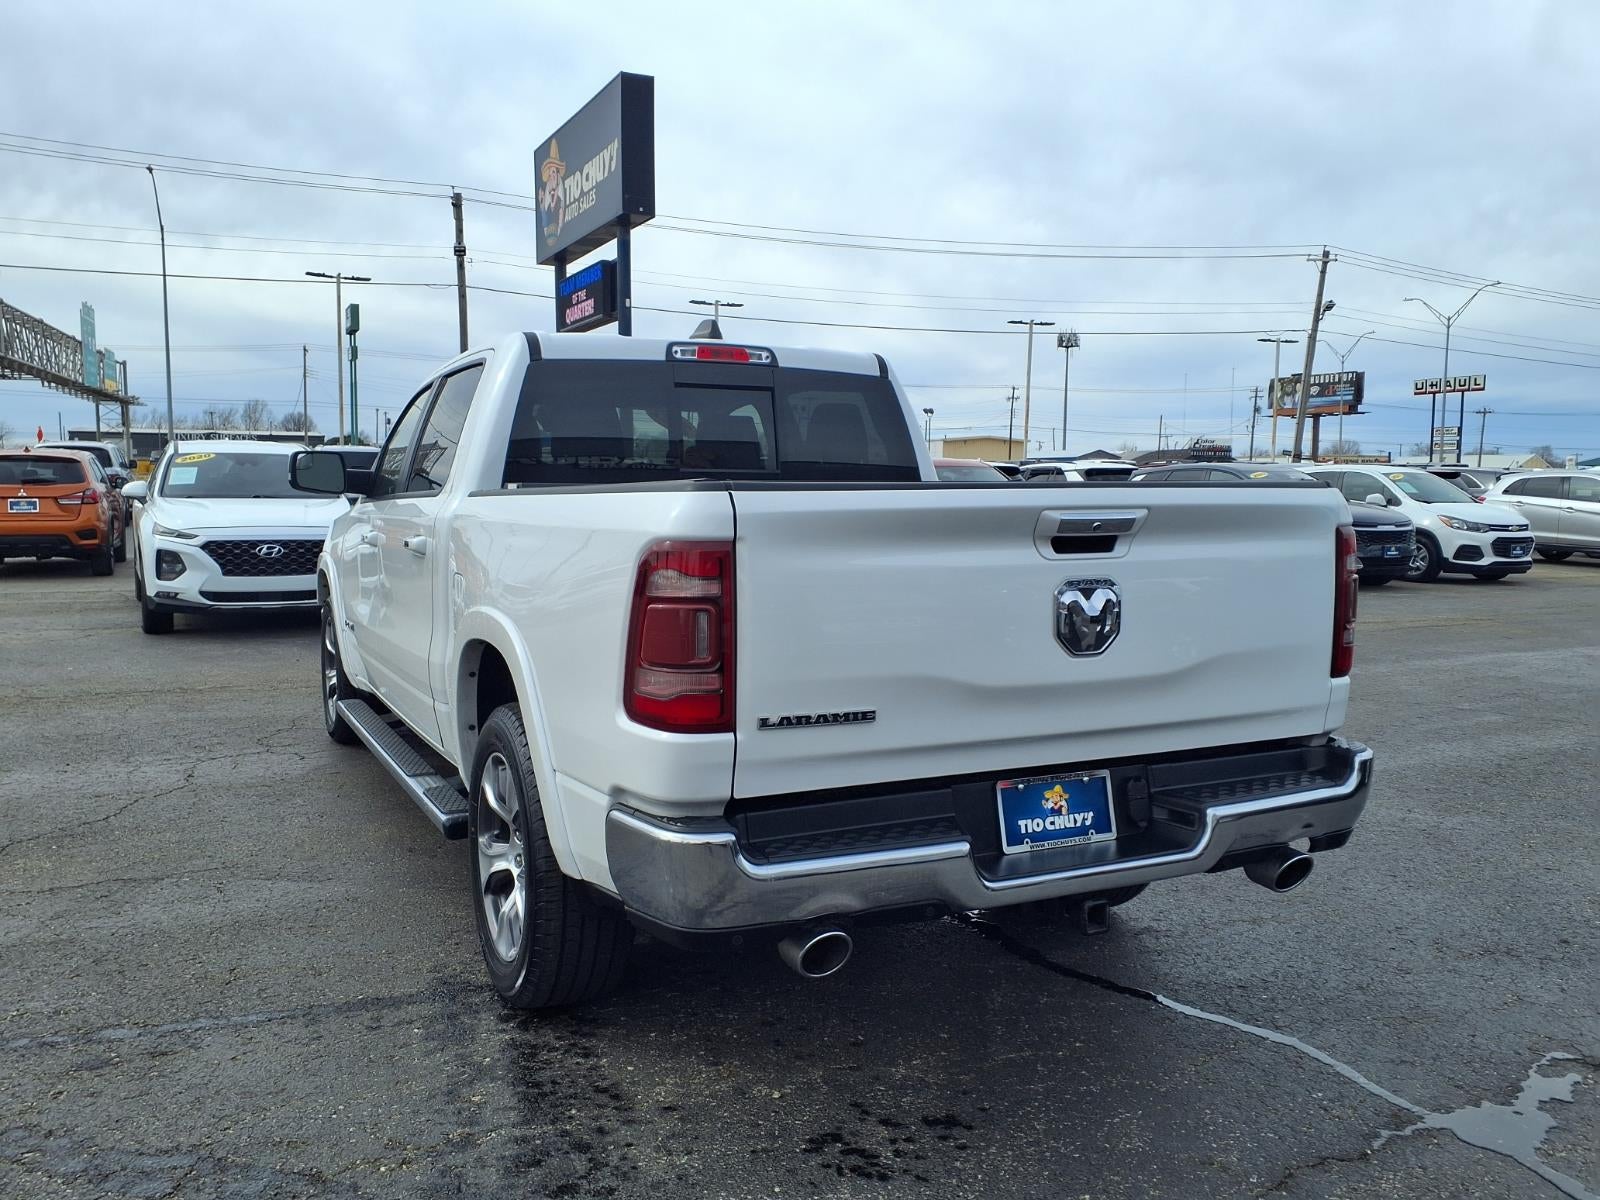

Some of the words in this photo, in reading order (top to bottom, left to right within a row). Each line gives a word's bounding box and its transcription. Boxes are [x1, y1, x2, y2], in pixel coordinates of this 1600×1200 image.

[565, 171, 581, 205] TIO
[582, 137, 618, 193] CHUY'S
[565, 201, 579, 223] AUTO
[580, 189, 596, 213] SALES
[572, 293, 578, 304] OF
[578, 289, 587, 302] THE
[565, 298, 594, 325] QUARTER!
[1309, 374, 1339, 385] HUNDER
[1343, 372, 1357, 382] UP!
[174, 433, 208, 441] UXURY
[210, 433, 258, 441] SURFACES
[181, 454, 211, 462] 2020
[759, 710, 876, 729] LARAMIE
[1018, 818, 1044, 834] TIO
[1044, 811, 1094, 831] CHUY'S
[1029, 836, 1092, 850] WWW.TIOCHUYS.COM
